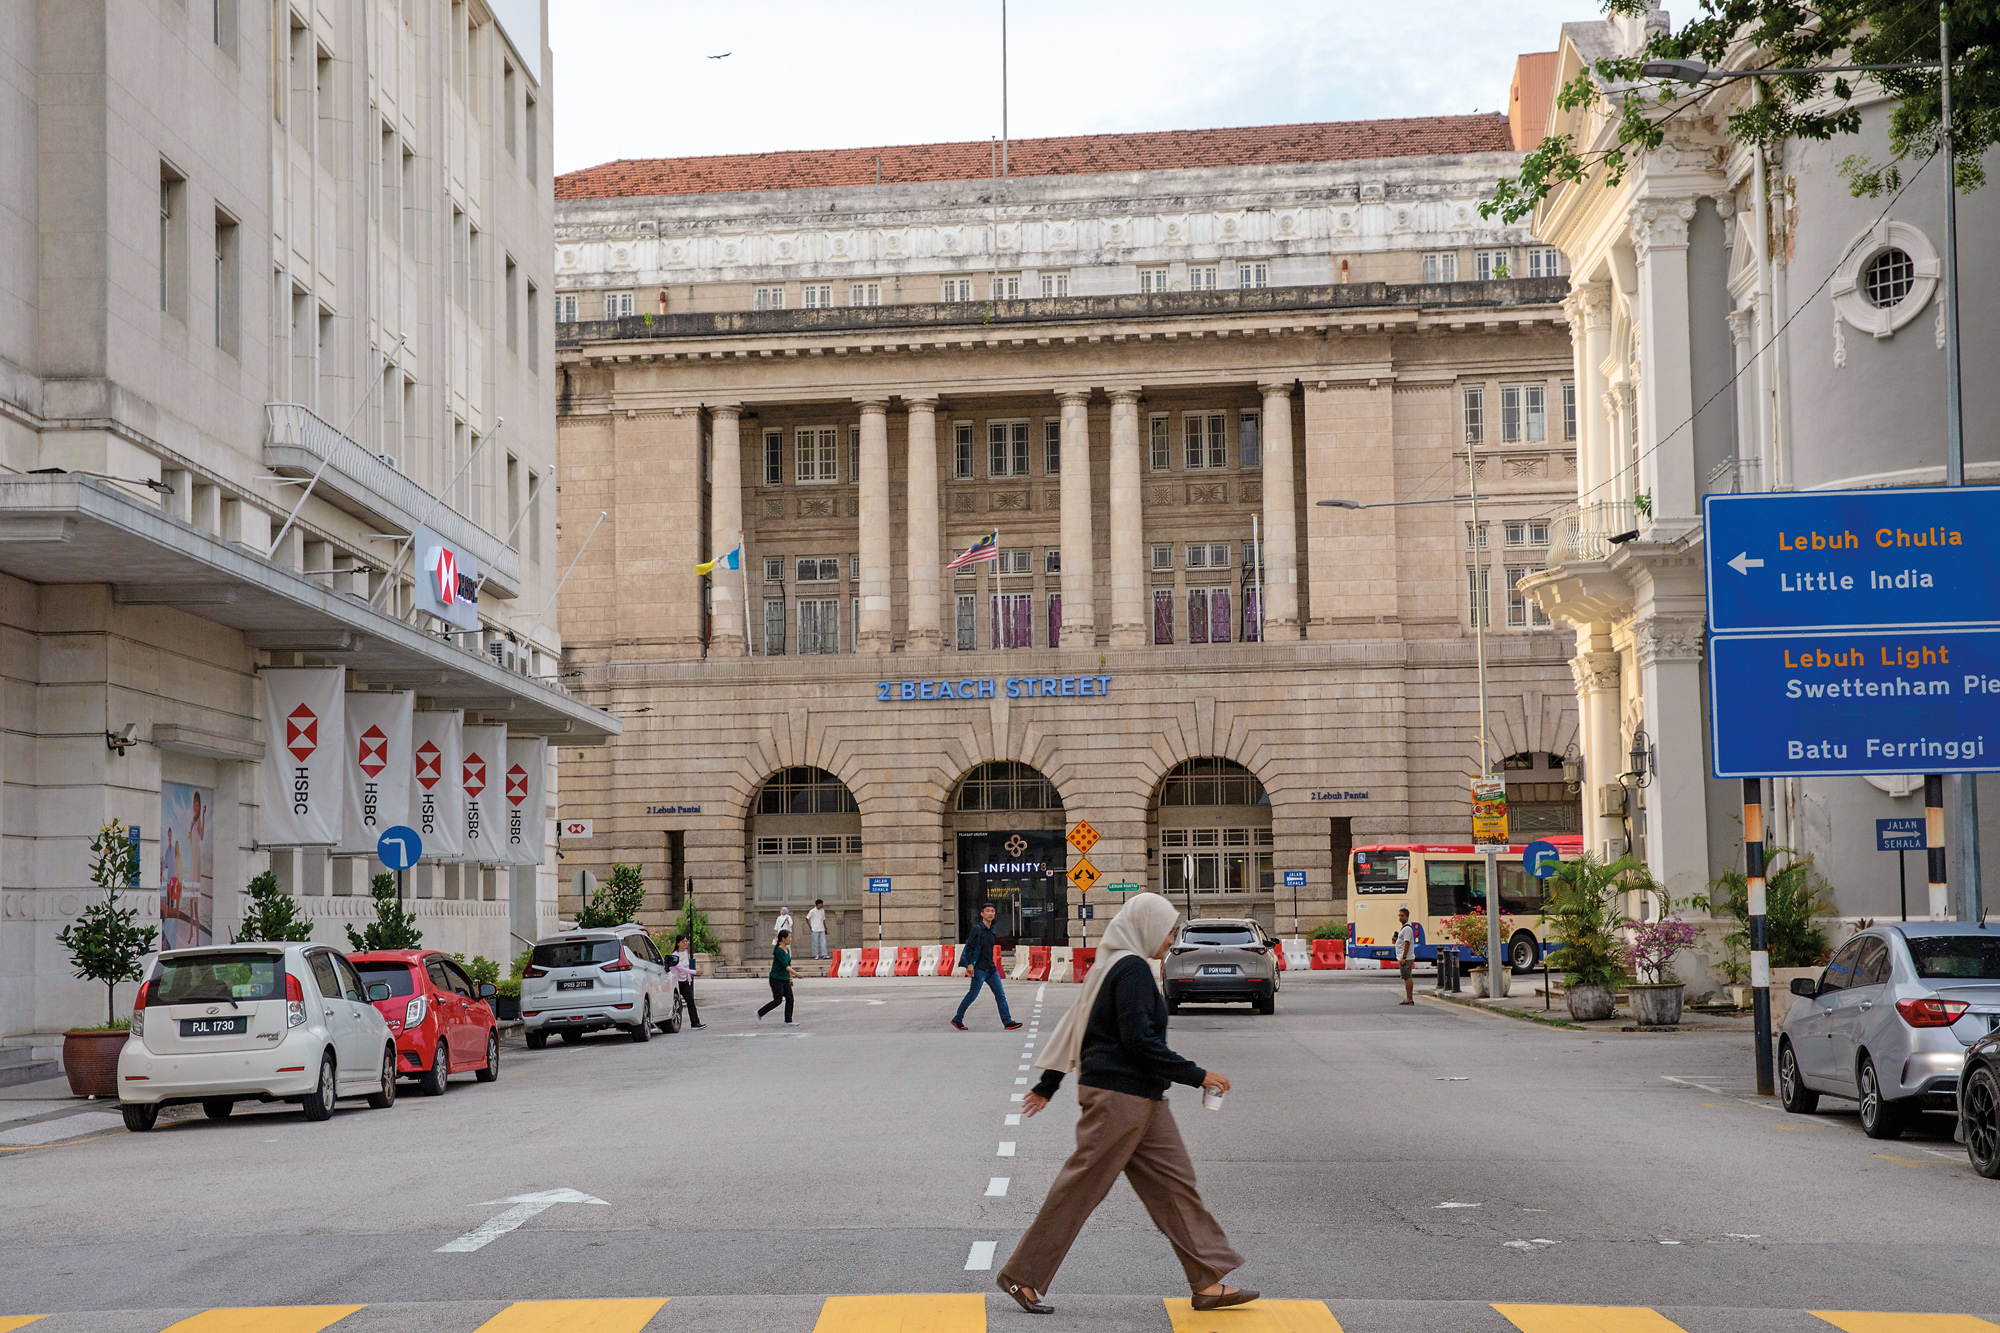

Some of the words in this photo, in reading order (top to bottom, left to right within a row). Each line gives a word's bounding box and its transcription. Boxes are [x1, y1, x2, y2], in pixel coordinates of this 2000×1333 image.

[1779, 530, 1859, 551] Lebuh
[1875, 527, 1963, 548] Chulia
[1781, 571, 1854, 592] Little
[1870, 569, 1934, 589] India
[1784, 648, 1865, 668] Lebuh
[1881, 645, 1950, 669] Light
[877, 681, 892, 701] 2
[900, 679, 995, 700] BEACH
[1006, 676, 1112, 698] STREET
[1785, 677, 1950, 699] Swettenham
[1964, 675, 2000, 694] Pie
[1788, 740, 1847, 760] Batu
[1866, 735, 1984, 760] Ferringgi
[293, 767, 309, 815] HSBC
[1311, 792, 1316, 800] 2
[1317, 791, 1342, 800] Lebuh
[1344, 791, 1369, 800] Pantai
[363, 782, 378, 826] HSBC
[422, 793, 434, 834] HSBC
[647, 806, 652, 814] 2
[653, 806, 676, 814] Lebuh
[677, 805, 701, 813] Pantai
[467, 801, 479, 839] HSBC
[510, 809, 521, 845] HSBC
[1887, 820, 1917, 830] JALAN
[1884, 840, 1921, 849] SEHALA
[192, 1022, 210, 1032] PJL
[212, 1020, 234, 1031] 1730
